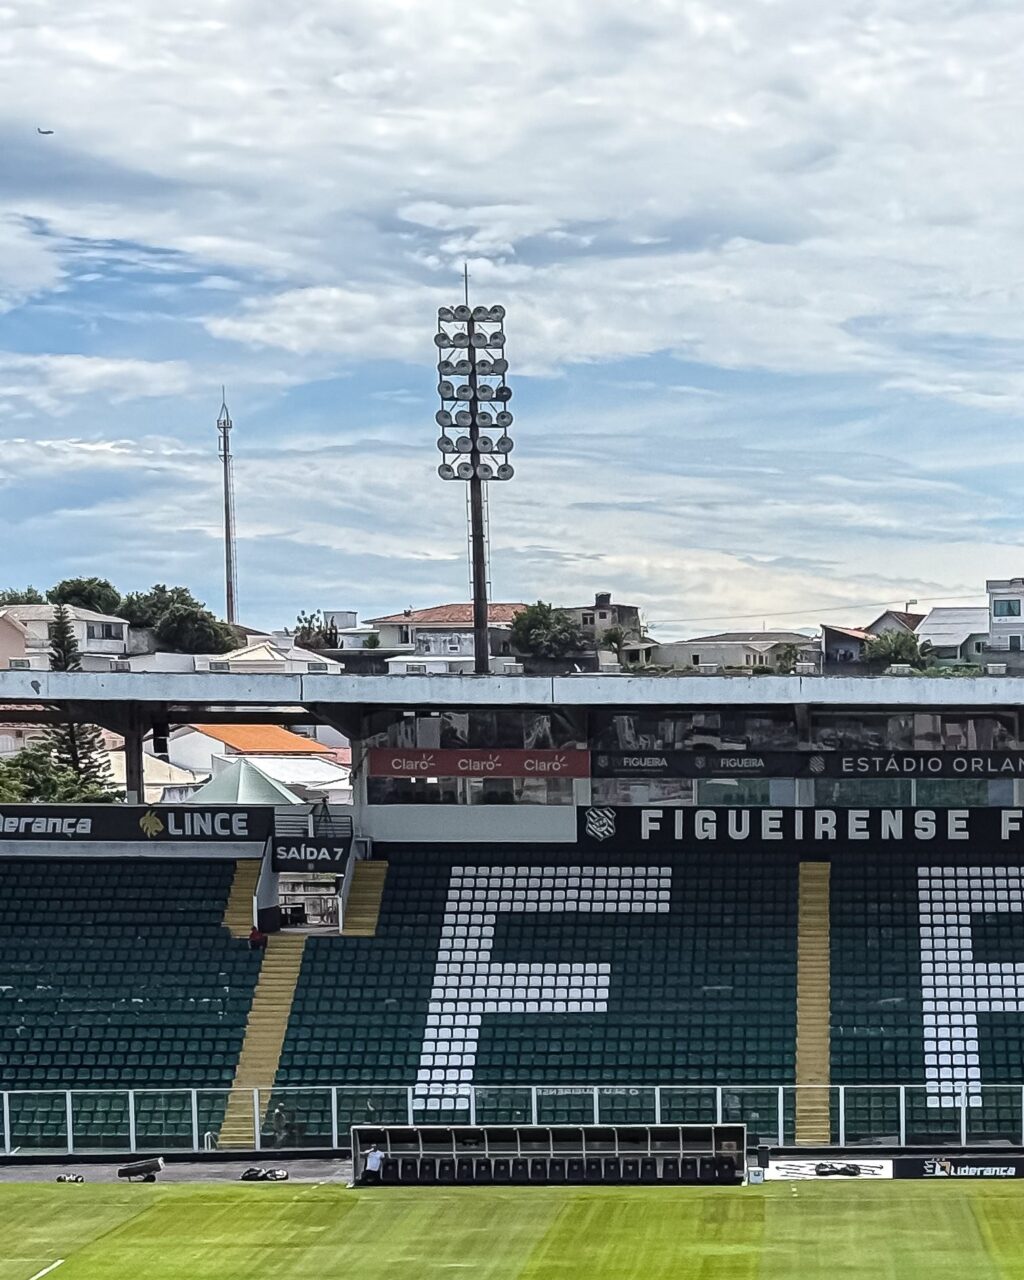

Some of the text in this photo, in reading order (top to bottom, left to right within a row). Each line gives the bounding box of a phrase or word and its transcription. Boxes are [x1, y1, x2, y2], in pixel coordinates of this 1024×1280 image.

[391, 756, 429, 771] Claro
[457, 757, 496, 772] Claro
[523, 758, 561, 772] Claro
[842, 754, 943, 772] ESTÁDIO
[0, 812, 93, 837] erança
[167, 812, 249, 836] LINCE
[641, 809, 970, 840] FIGUEIRENSE
[276, 844, 344, 861] SAÍDA 7
[950, 1165, 1017, 1178] Liderança
